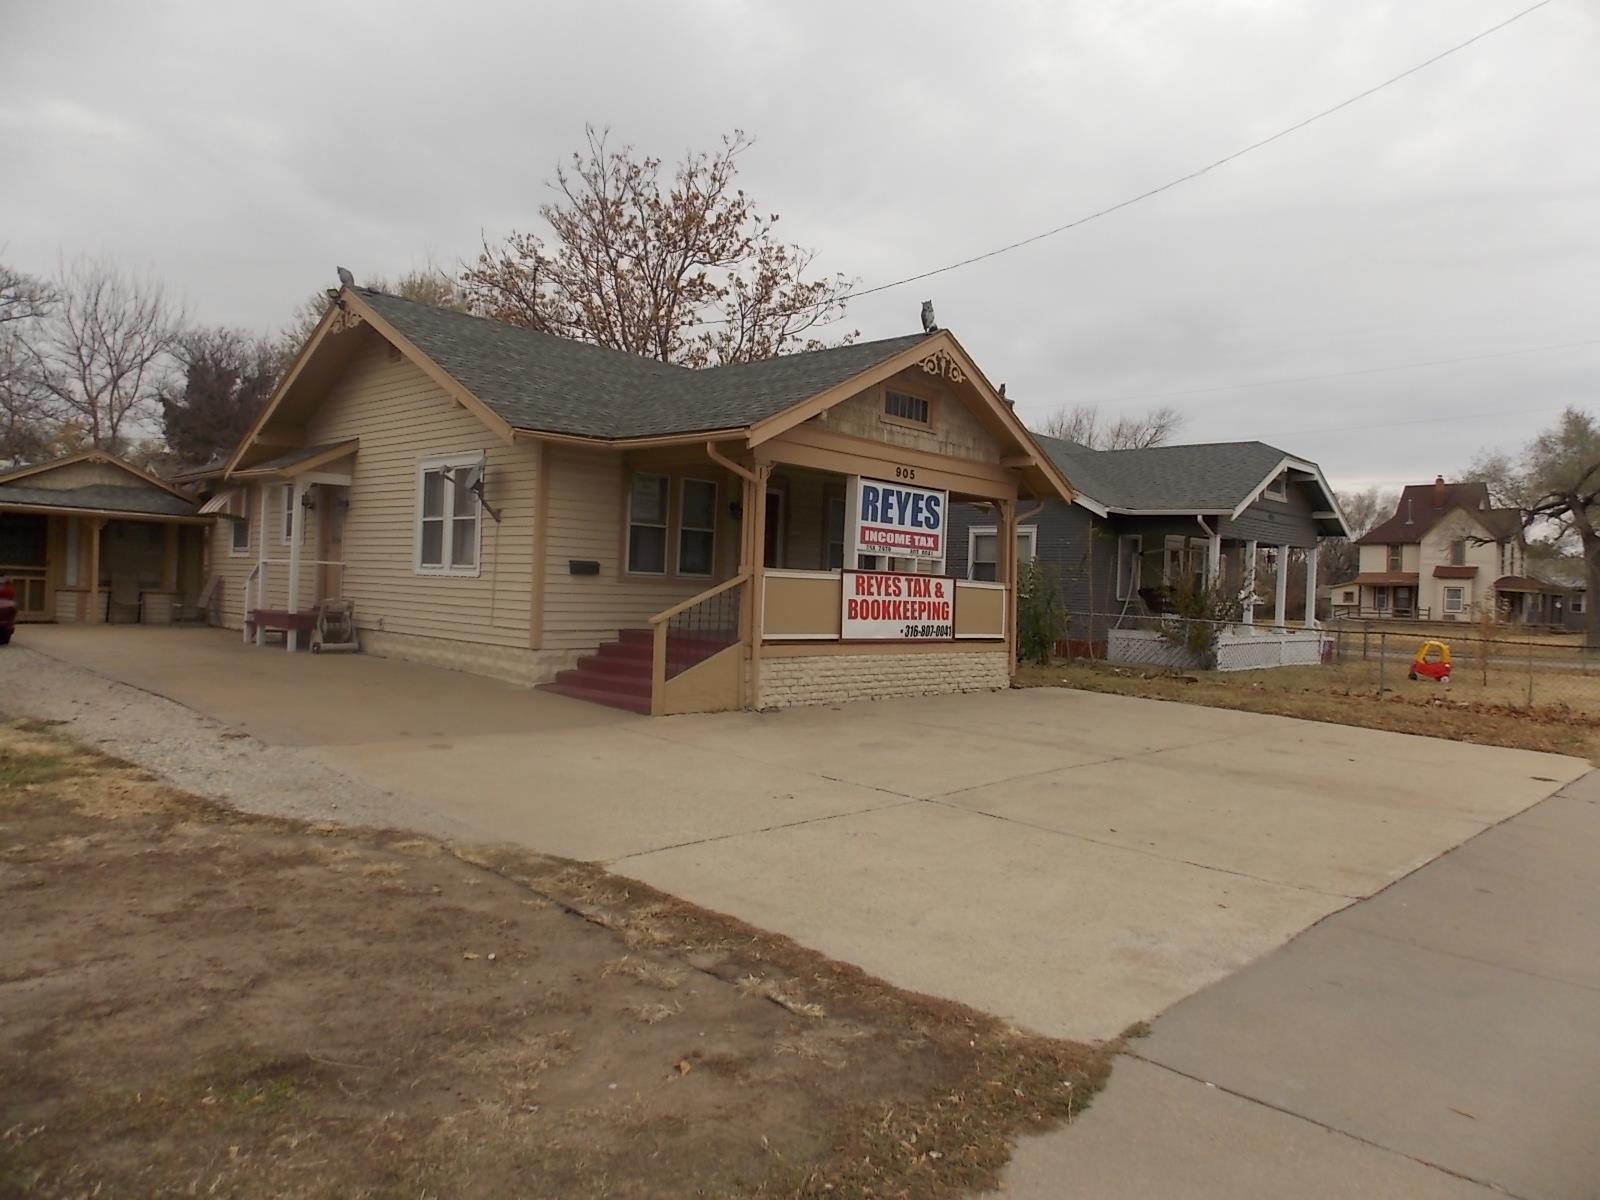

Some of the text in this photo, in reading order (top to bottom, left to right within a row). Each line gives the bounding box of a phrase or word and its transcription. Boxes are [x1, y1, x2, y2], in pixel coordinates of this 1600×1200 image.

[896, 467, 915, 480] 905
[861, 485, 941, 530] REYES
[864, 530, 935, 548] INCOME TAX
[855, 574, 945, 599] REYES TAX &
[847, 598, 950, 621] BOOKKEEPING
[904, 624, 952, 638] 316-807-0041
